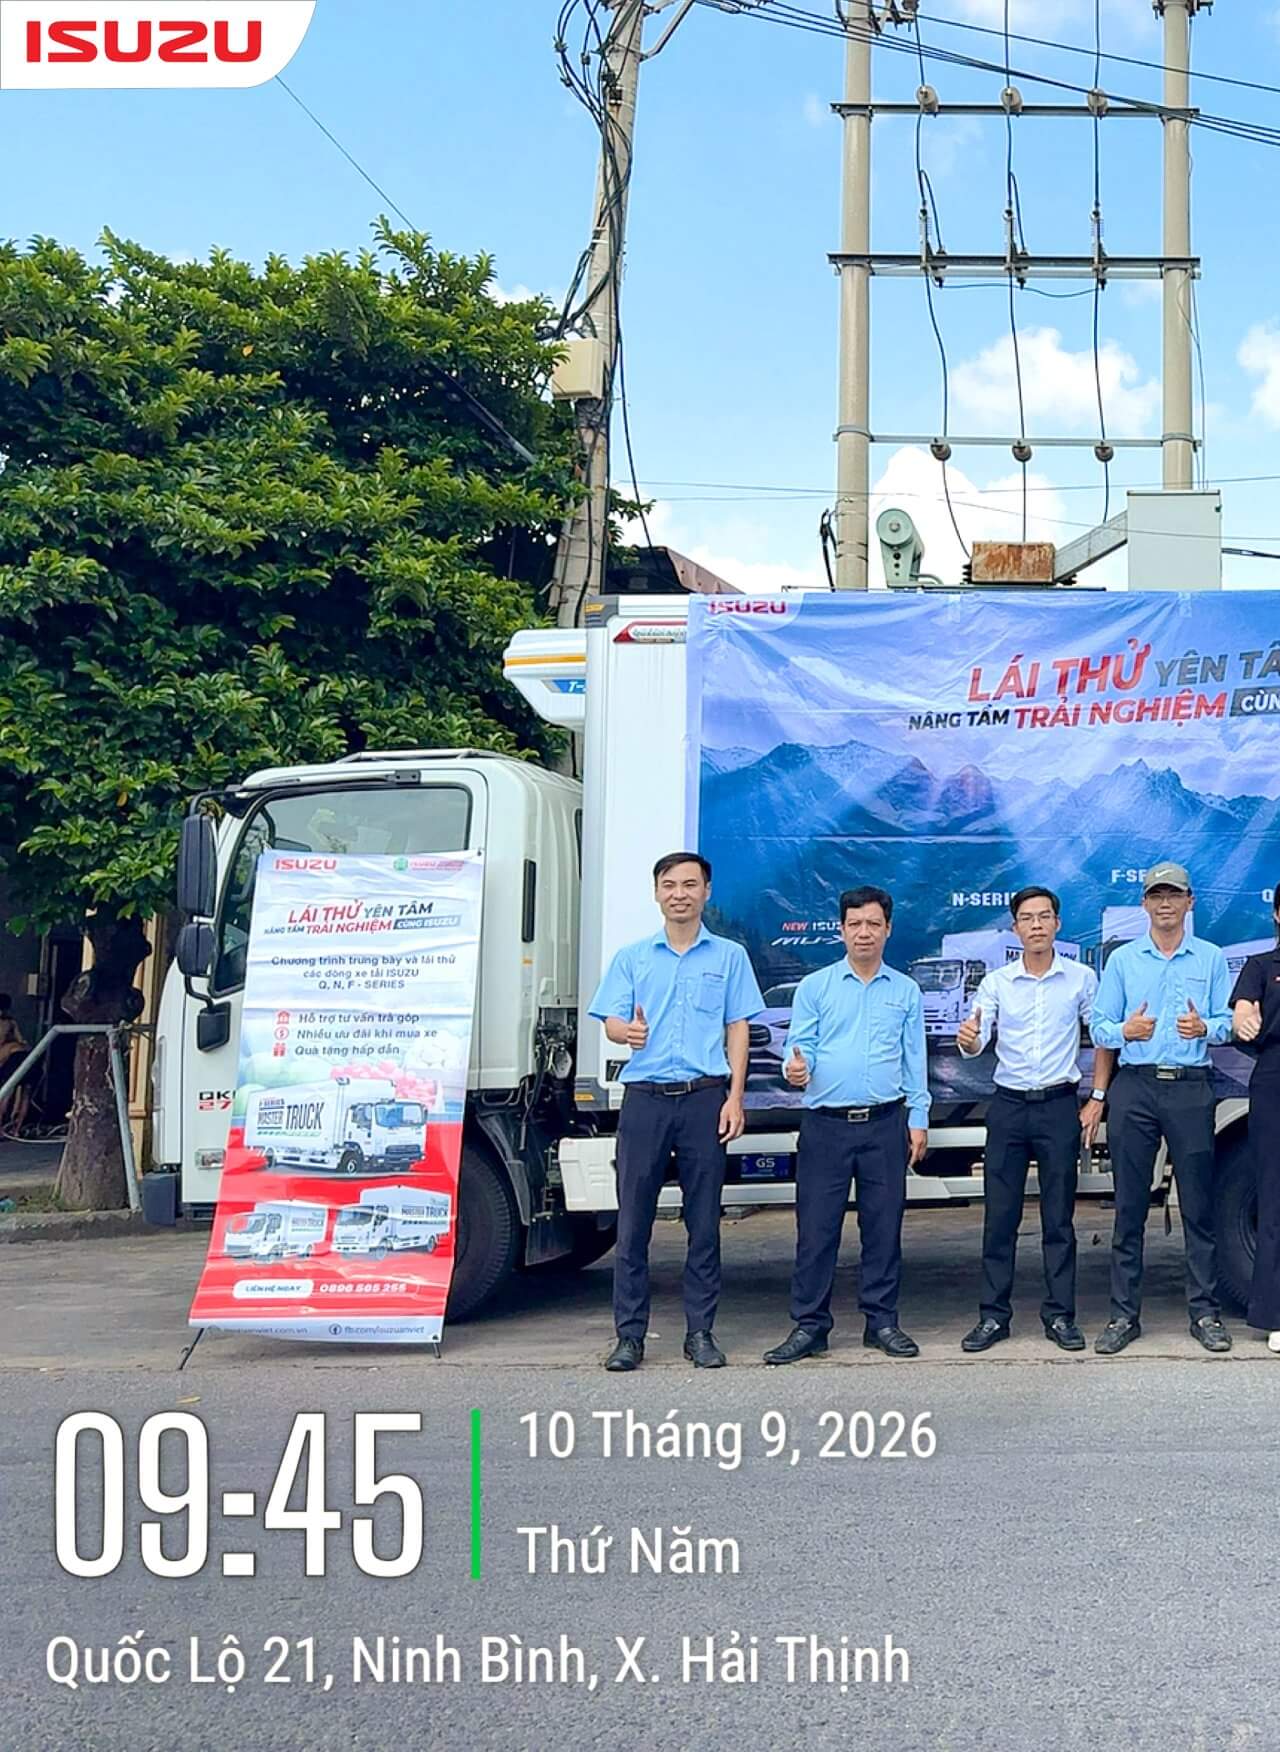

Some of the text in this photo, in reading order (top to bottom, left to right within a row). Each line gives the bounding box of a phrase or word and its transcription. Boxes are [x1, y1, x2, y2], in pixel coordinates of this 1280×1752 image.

[711, 600, 787, 615] ISUZU
[967, 653, 1042, 703] LÁI
[1053, 637, 1153, 697] THỬ
[1155, 648, 1229, 688] YÊN
[908, 711, 962, 731] NÂNG
[1015, 696, 1080, 730] TRẢI
[1089, 688, 1228, 729] NGHIỆM
[275, 859, 337, 870] ISUZU
[952, 892, 1017, 906] N-SERI
[288, 899, 434, 924] LÁI THỬ YÊN TÂM
[335, 918, 392, 935] NGHIỆM
[782, 921, 808, 932] NEW
[303, 968, 323, 978] các
[386, 968, 419, 977] ISUZU
[347, 980, 355, 989] F
[364, 980, 405, 989] SERIES
[397, 1012, 420, 1025] góp
[374, 1028, 391, 1038] khi
[395, 1030, 420, 1038] mua
[286, 1102, 324, 1130] TRUCK
[755, 1157, 776, 1169] GS
